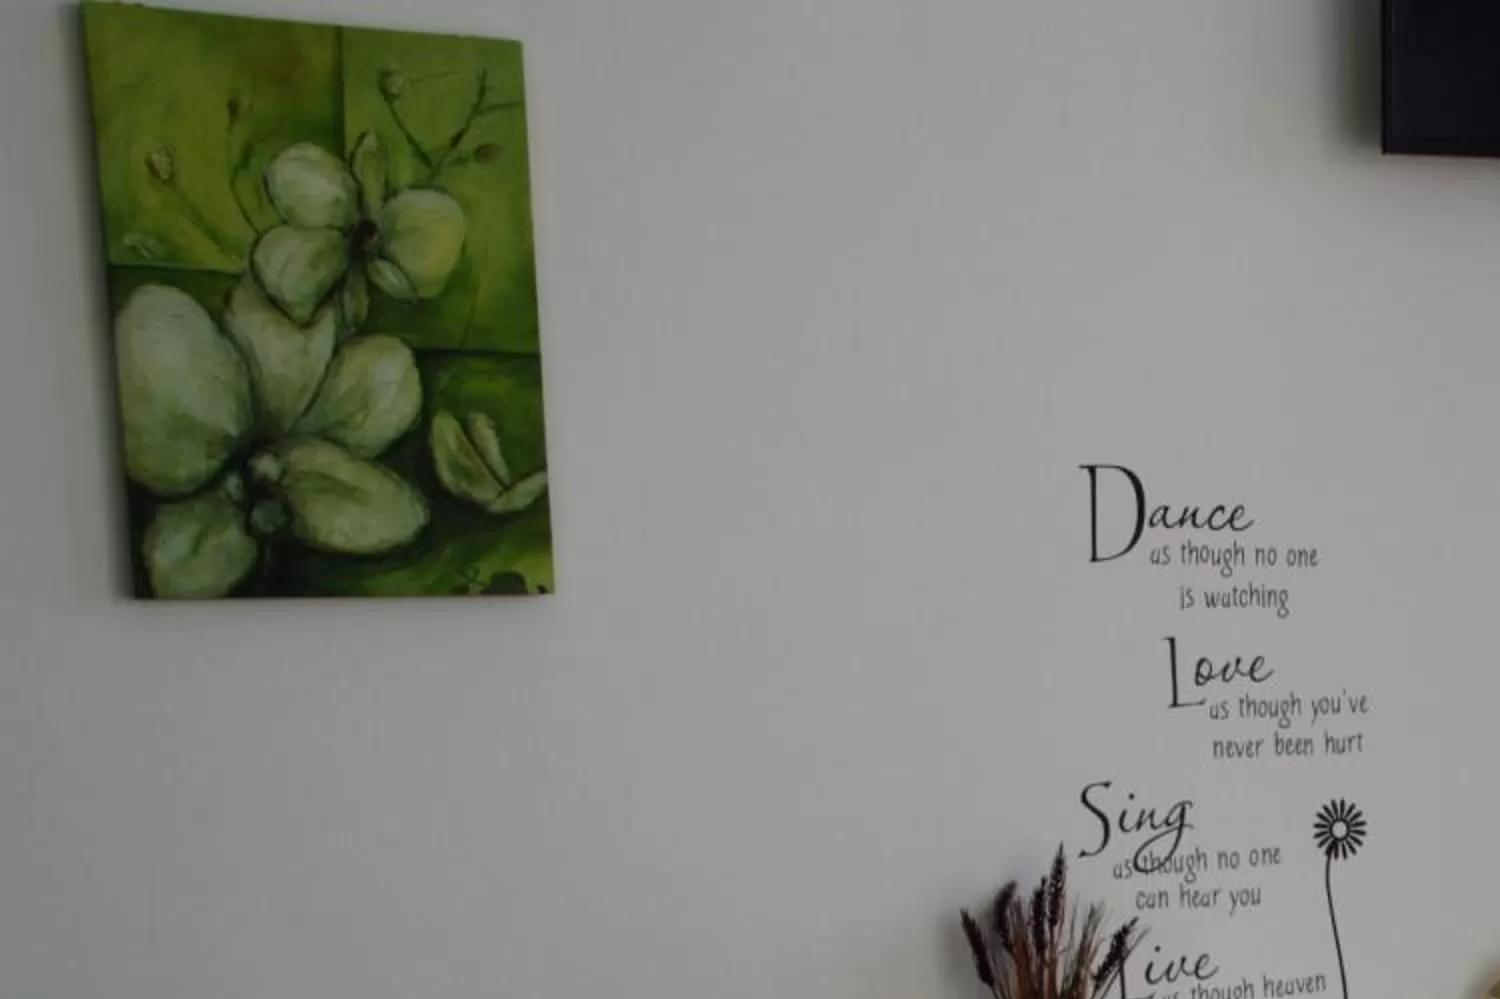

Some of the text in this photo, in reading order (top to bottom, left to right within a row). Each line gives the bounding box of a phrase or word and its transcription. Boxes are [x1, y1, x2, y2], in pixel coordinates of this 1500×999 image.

[1077, 463, 1255, 564] Dance
[1149, 539, 1318, 578] as though no one
[1180, 582, 1290, 619] is watching
[1163, 635, 1275, 709] Love
[1209, 689, 1369, 729] as though you've
[1212, 731, 1364, 759] never been hurt
[1077, 780, 1195, 876] Sing
[1112, 846, 1281, 885] as though no one
[1135, 883, 1261, 917] can hear you
[1263, 973, 1327, 998] heaven
